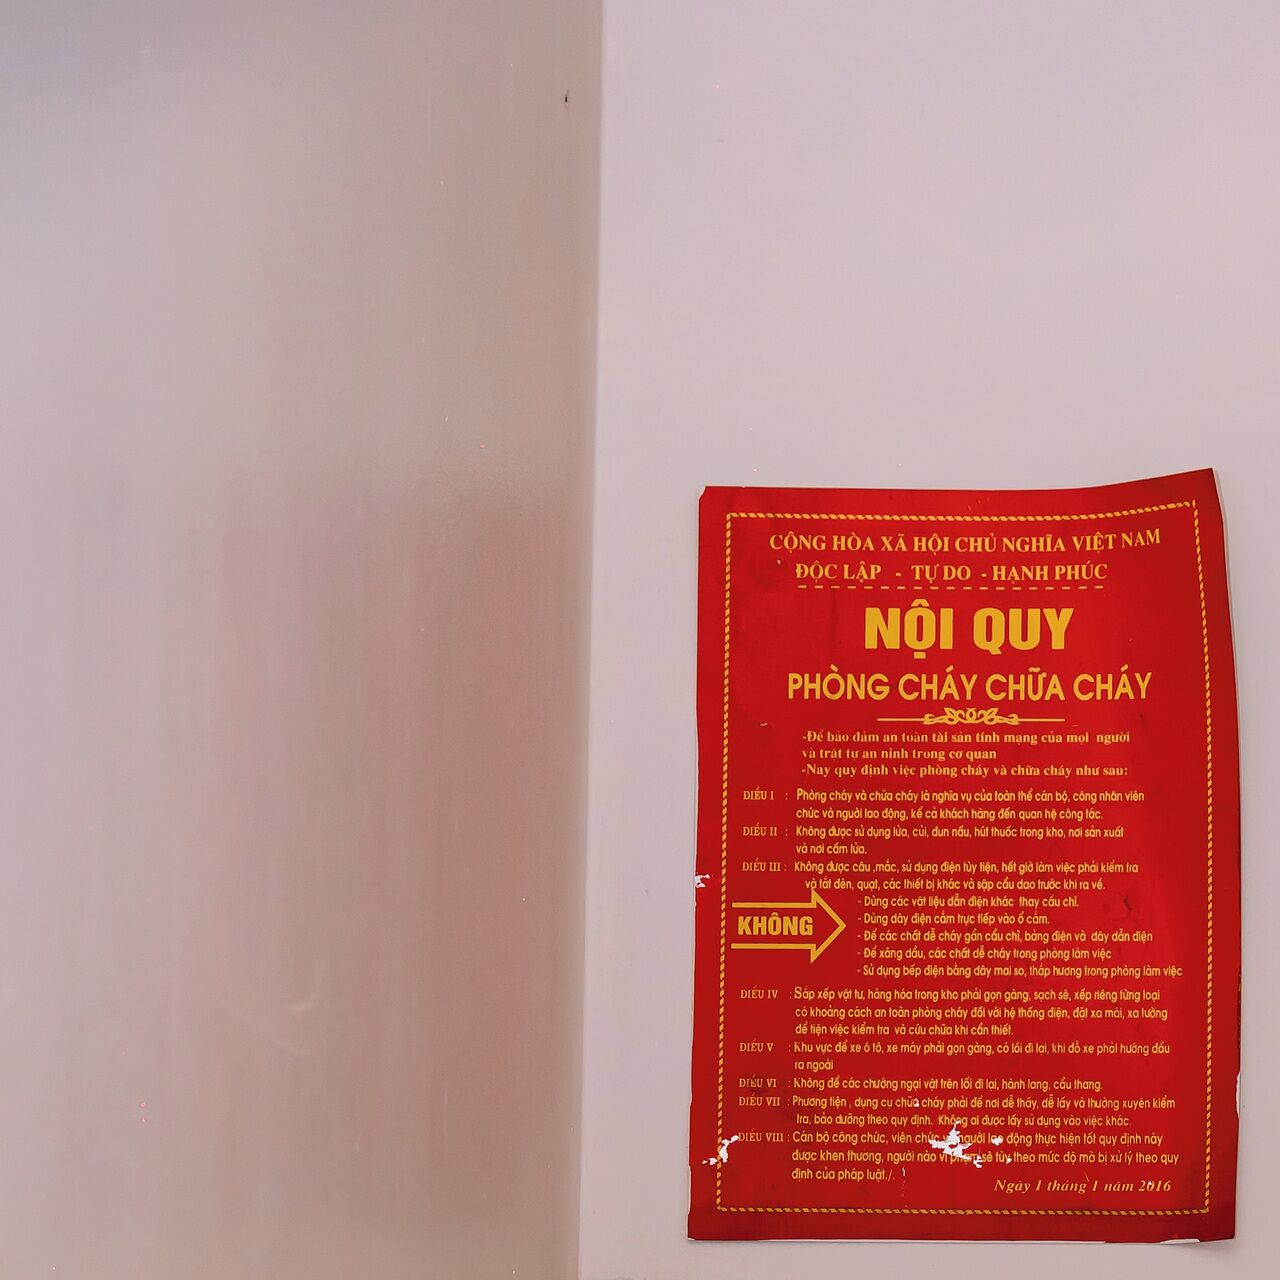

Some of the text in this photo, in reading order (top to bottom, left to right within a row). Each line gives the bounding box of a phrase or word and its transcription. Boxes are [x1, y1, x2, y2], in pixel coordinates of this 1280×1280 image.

[769, 528, 1161, 555] CỘNG HÒA XÃ HỘI CHỦ NGHĨA VIỆT NAM
[795, 560, 1108, 585] ĐỘC LẬP TỰ DO HẠNH PHÚC
[864, 598, 1074, 659] NỘI QUY
[788, 664, 1152, 701] PHÒNG CHÁY CHỮA CHÁY
[882, 734, 898, 743] an
[901, 732, 929, 743] toàn
[932, 731, 948, 743] tài
[975, 731, 1000, 743] tính
[1003, 734, 1038, 747] mạng
[1040, 730, 1063, 743] của
[1066, 731, 1089, 746] mọi
[1096, 731, 1130, 746] người
[802, 747, 816, 759] và
[862, 750, 877, 759] an
[881, 747, 909, 759] ninh
[912, 749, 946, 762] trong
[948, 750, 963, 759] cơ
[965, 750, 997, 762] quan
[834, 767, 857, 778] quy
[919, 764, 958, 778] phòng
[960, 764, 990, 778] cháy
[993, 764, 1008, 776] và
[1010, 764, 1040, 776] chữa
[1043, 764, 1072, 779] cháy
[1075, 764, 1100, 776] như
[1102, 767, 1128, 776] sau:
[796, 787, 827, 804] Phòng
[827, 789, 853, 803] cháy
[854, 789, 867, 801] và
[894, 789, 919, 803] cháy
[920, 789, 930, 802] là
[960, 792, 972, 804] vụ
[973, 788, 993, 802] của
[994, 789, 1016, 802] toàn
[1034, 789, 1054, 802] cán
[1072, 790, 1098, 804] công
[1124, 790, 1145, 802] viên
[738, 912, 813, 936] KHÔNG
[994, 1179, 1031, 1194] Ngày
[1035, 1179, 1042, 1191] 1
[1047, 1179, 1088, 1194] tháng
[1092, 1180, 1099, 1192] 1
